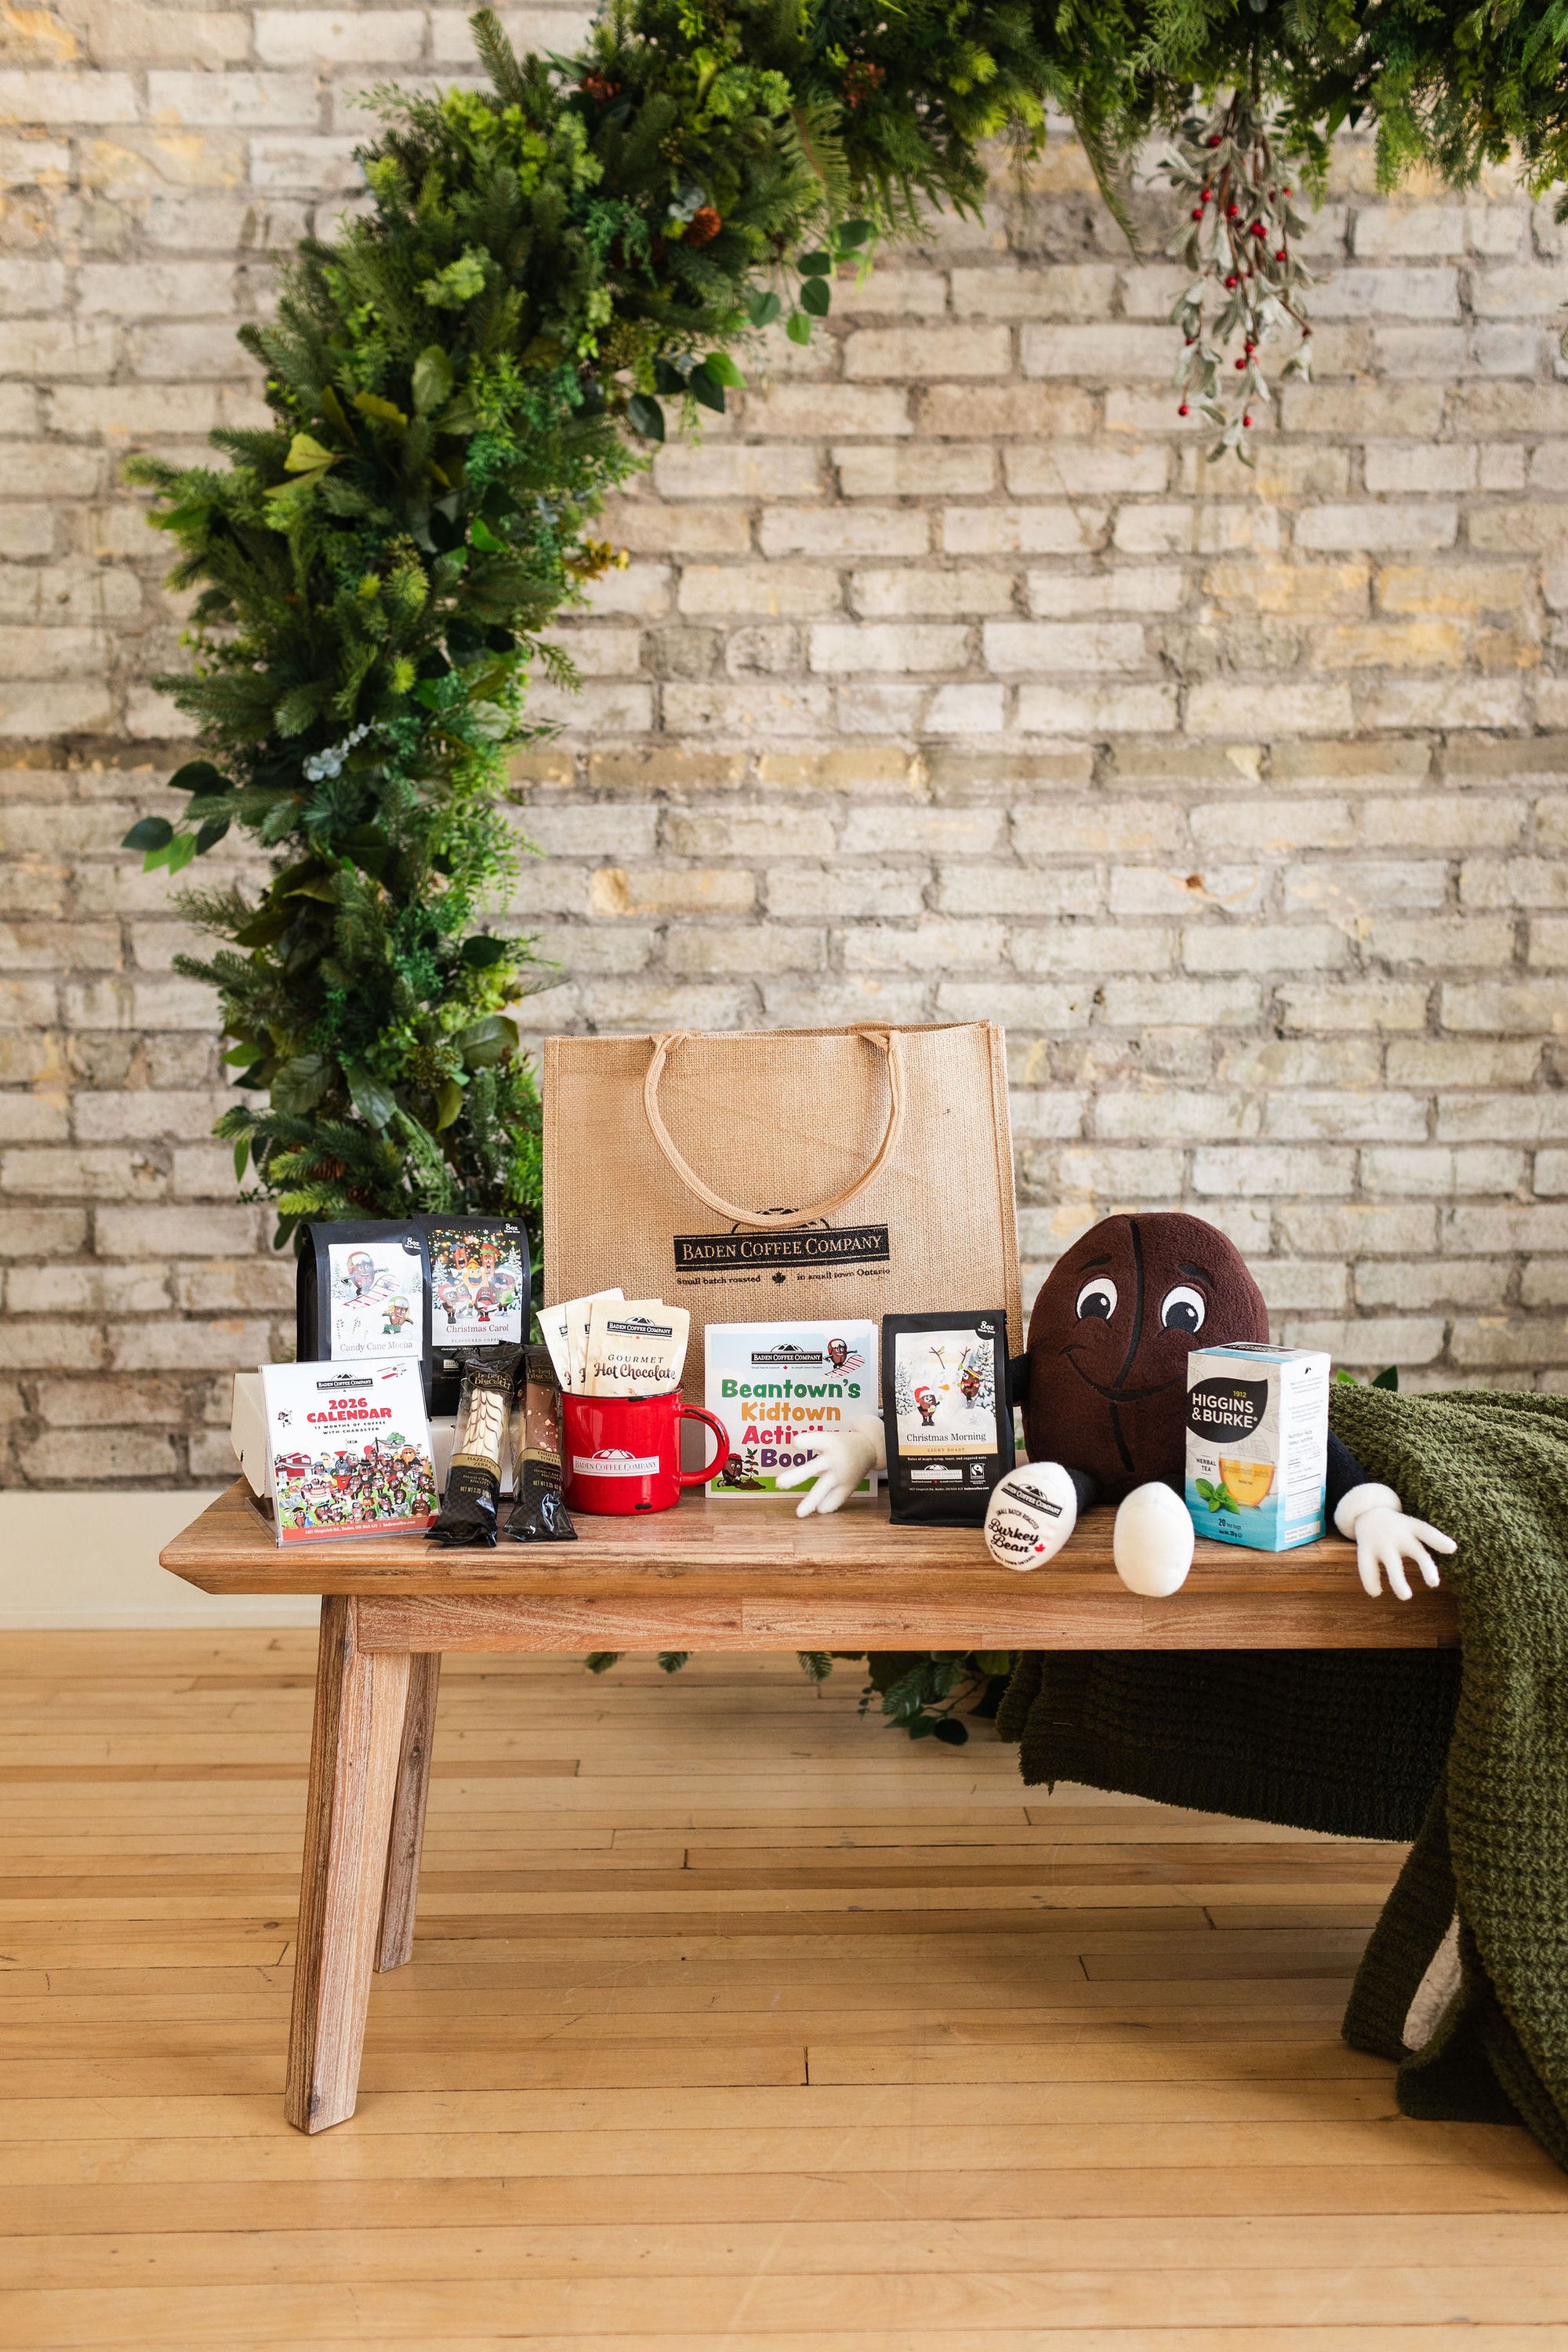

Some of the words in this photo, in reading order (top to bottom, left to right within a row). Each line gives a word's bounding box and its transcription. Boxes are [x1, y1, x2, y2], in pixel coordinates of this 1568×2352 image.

[407, 1237, 420, 1247] 8oz
[681, 1243, 736, 1261] BADEN
[740, 1238, 802, 1258] COFFEE
[805, 1235, 883, 1255] COMPANY
[808, 1270, 833, 1279] small
[834, 1270, 856, 1279] town
[857, 1268, 891, 1278] Ontario
[677, 1277, 701, 1286] Small
[703, 1276, 726, 1285] batch
[728, 1275, 761, 1283] roasted
[446, 1325, 487, 1334] Christmas
[647, 1326, 672, 1334] COMPANY
[980, 1320, 994, 1330] 8oz
[339, 1344, 366, 1353] Candy
[367, 1342, 387, 1352] Cane
[608, 1354, 664, 1363] GOURMET
[593, 1362, 619, 1379] Hot
[619, 1363, 677, 1381] Chocolate
[722, 1379, 861, 1398] Beantown's
[328, 1398, 368, 1410] 2026
[1192, 1393, 1254, 1414] HIGGINS
[307, 1408, 392, 1423] CALENDAR
[741, 1402, 840, 1422] Kidtown
[951, 1432, 986, 1441] Morning
[467, 1457, 497, 1469] HAZELNUT
[474, 1461, 492, 1470] ZEBRA
[575, 1461, 594, 1469] BADEN
[623, 1461, 656, 1471] COMPANY
[1218, 1518, 1225, 1527] 20
[988, 1519, 1040, 1545] Burkey
[991, 1534, 1029, 1552] Bean
